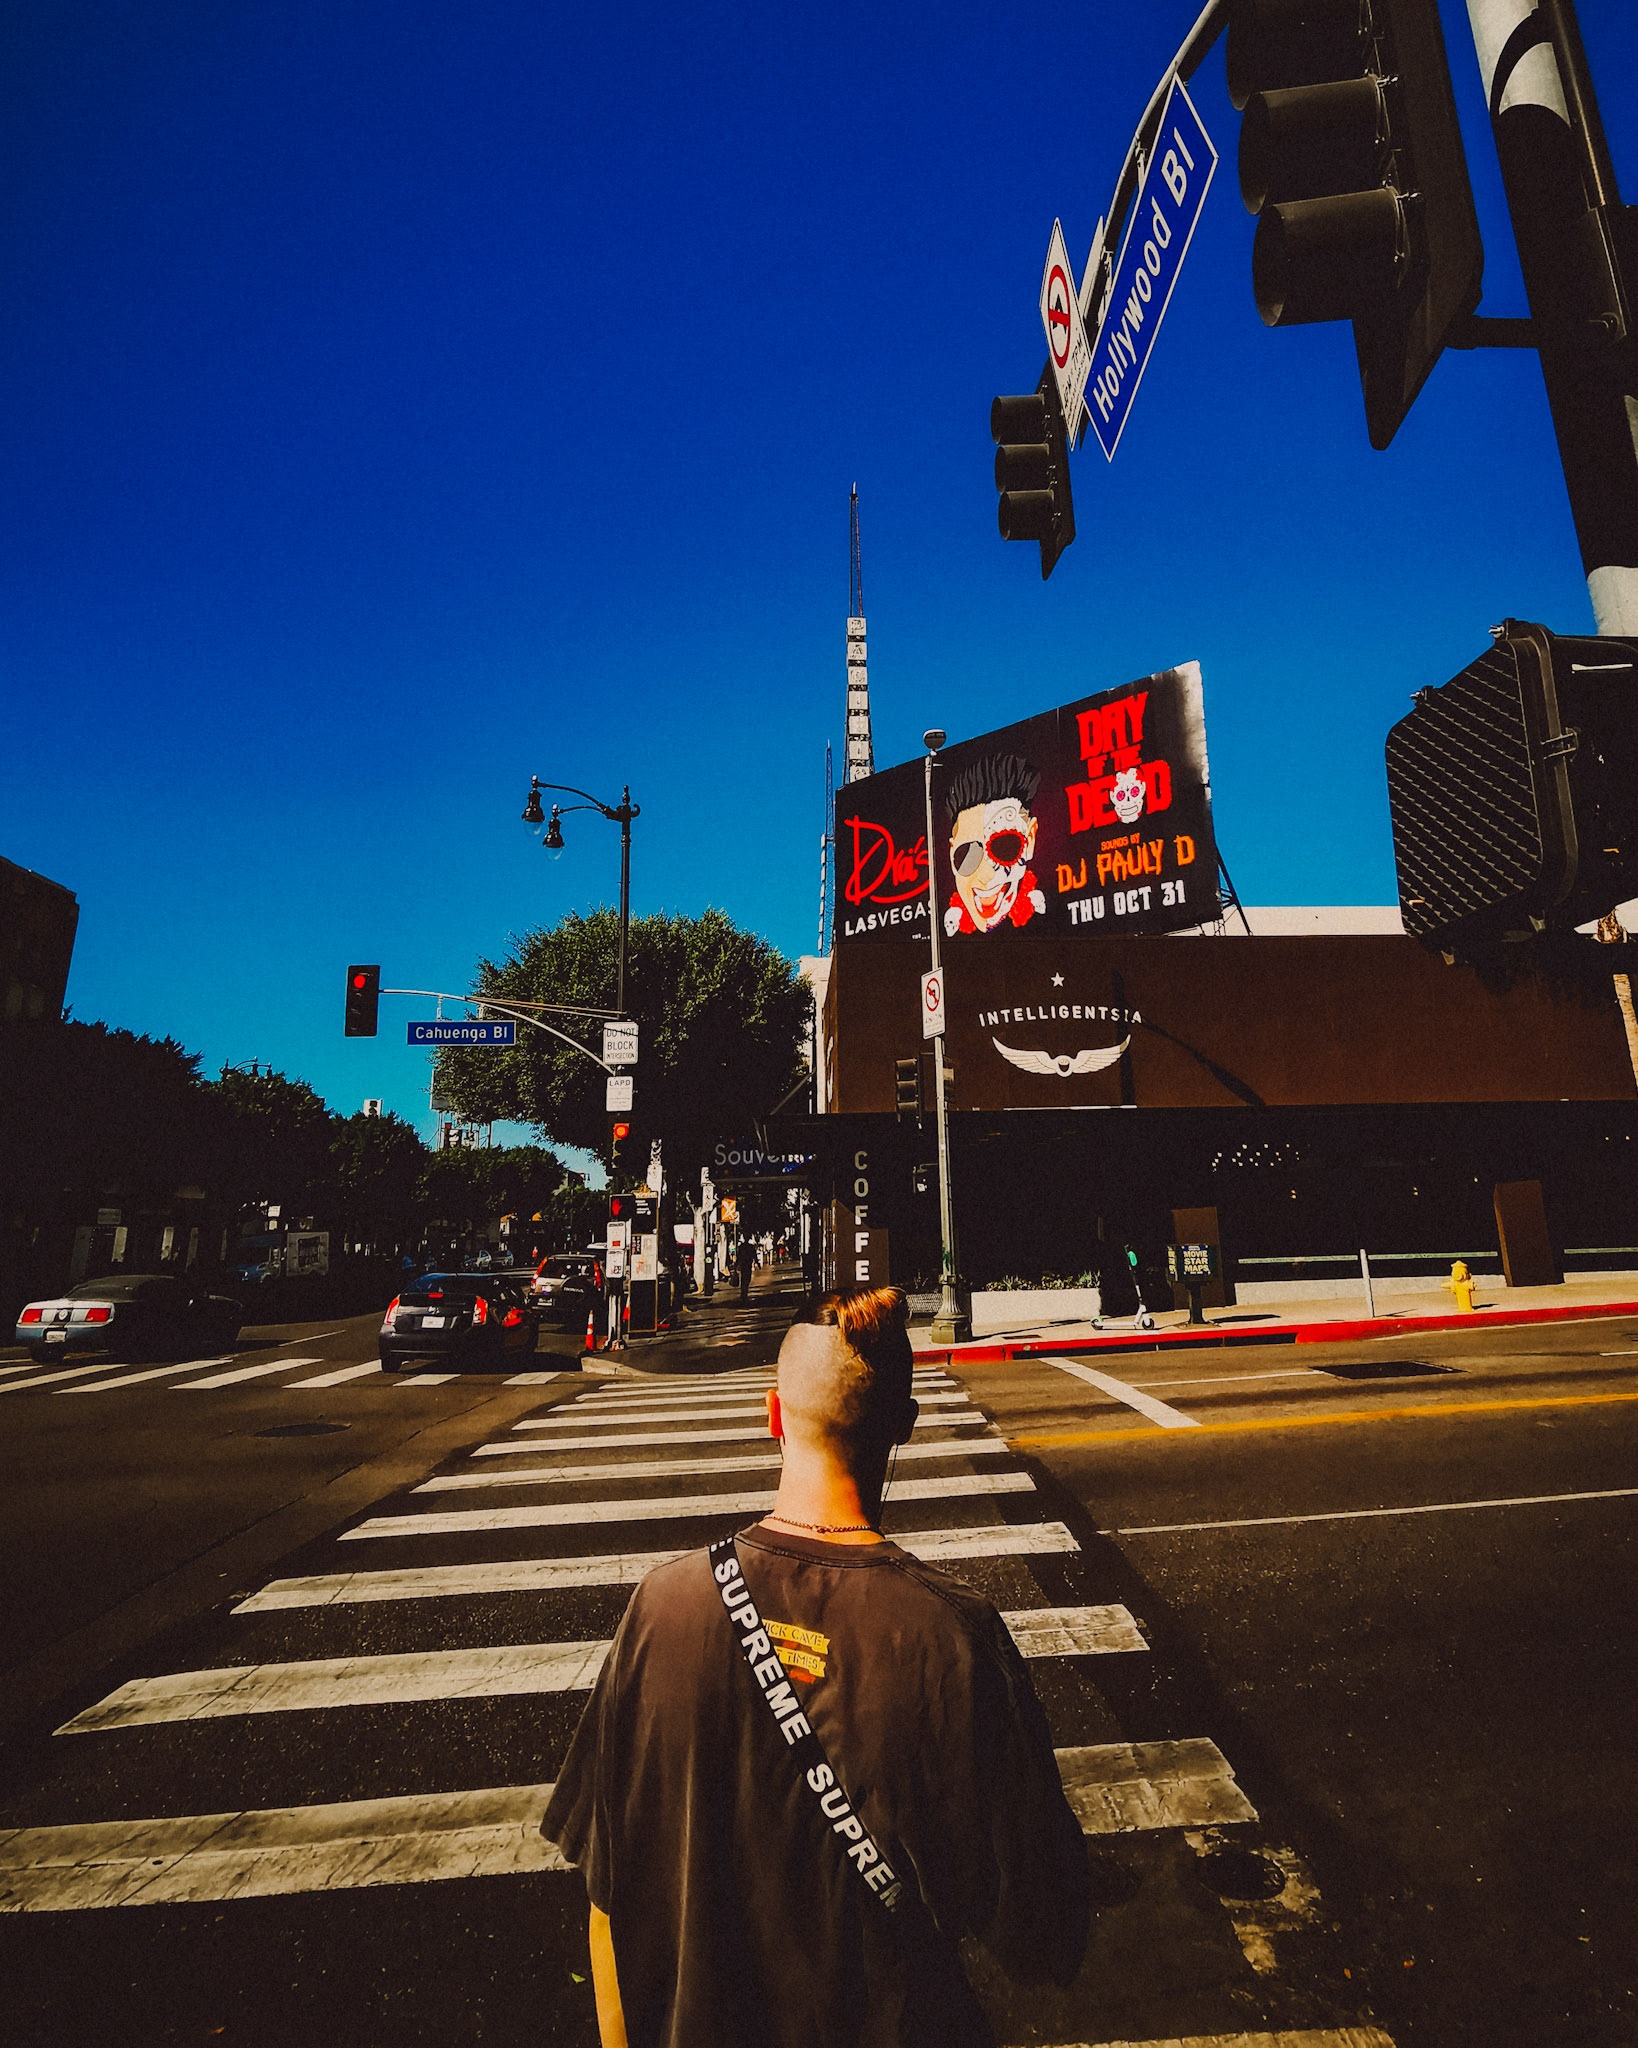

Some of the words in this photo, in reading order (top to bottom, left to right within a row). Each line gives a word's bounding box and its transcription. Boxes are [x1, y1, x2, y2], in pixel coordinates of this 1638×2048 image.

[1093, 196, 1172, 411] Hollywood
[1075, 691, 1149, 761] DAY
[1086, 754, 1108, 779] OF
[1110, 743, 1143, 773] THE
[1064, 759, 1173, 835] DED
[1100, 835, 1129, 852] SOUNDS
[1129, 832, 1141, 845] BY
[1056, 857, 1088, 894] DJ
[1096, 838, 1165, 887] PAULY
[1173, 834, 1196, 867] D
[1067, 895, 1105, 926] THU
[1113, 885, 1152, 916] OCT
[1160, 879, 1187, 906] 31
[978, 1005, 1143, 1027] INTELLIGENTSIA
[415, 1026, 487, 1043] Cahuenga
[606, 1028, 618, 1038] DO
[620, 1027, 636, 1038] NOT
[607, 1040, 634, 1051] BLOCK
[606, 1052, 635, 1060] INTERSECTION
[609, 1079, 631, 1087] LAPD
[854, 1150, 870, 1281] COFFE
[1183, 1250, 1208, 1258] MOVIE
[1184, 1257, 1209, 1265] STAR
[1184, 1264, 1209, 1272] MAPS
[791, 1628, 822, 1647] CAVE
[714, 1557, 812, 1746] SUPREME
[787, 1651, 818, 1670] TIMES
